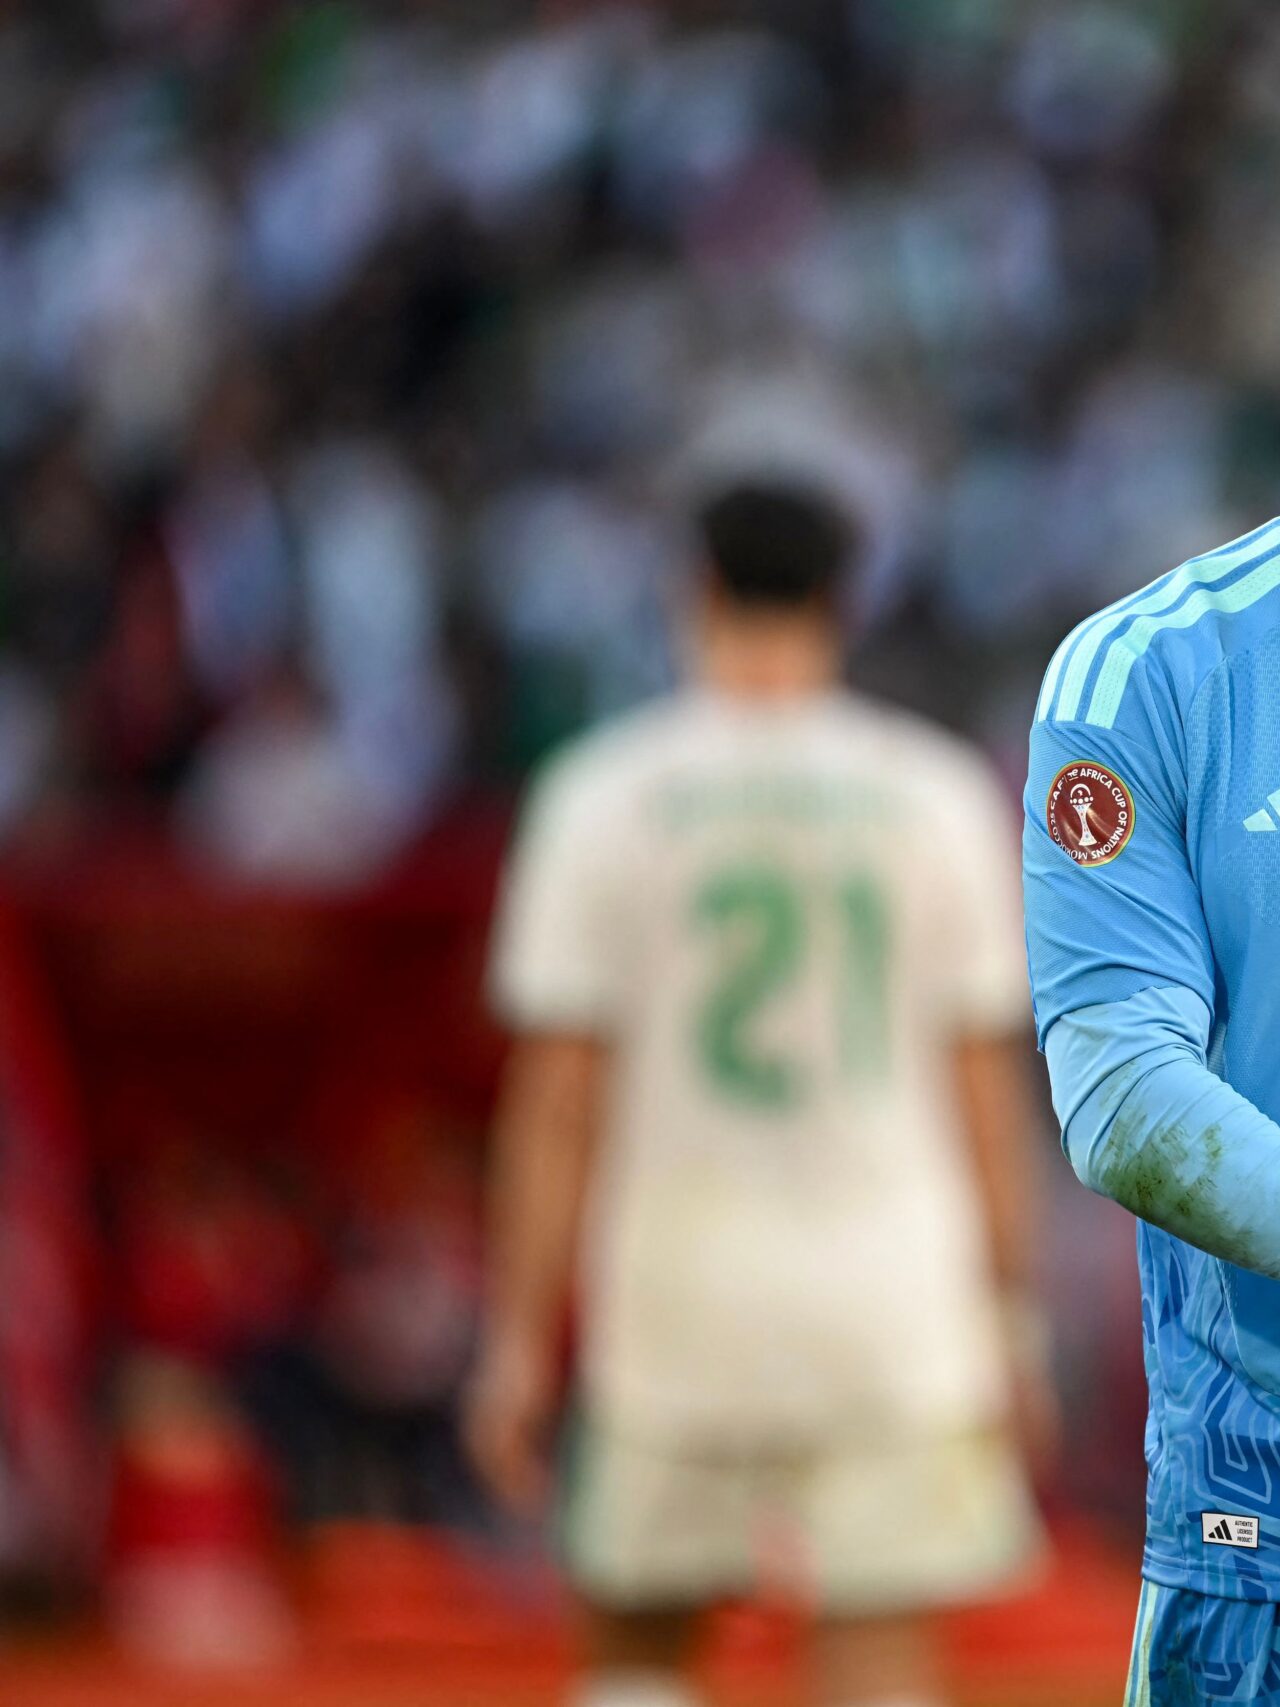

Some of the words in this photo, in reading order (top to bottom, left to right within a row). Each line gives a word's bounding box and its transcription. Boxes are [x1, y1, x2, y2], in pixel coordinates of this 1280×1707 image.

[1080, 767, 1113, 790] AFRICA
[1111, 787, 1126, 808] CUP
[1118, 811, 1128, 827] OF
[1091, 826, 1125, 860] NATIONS
[694, 867, 893, 1106] 21
